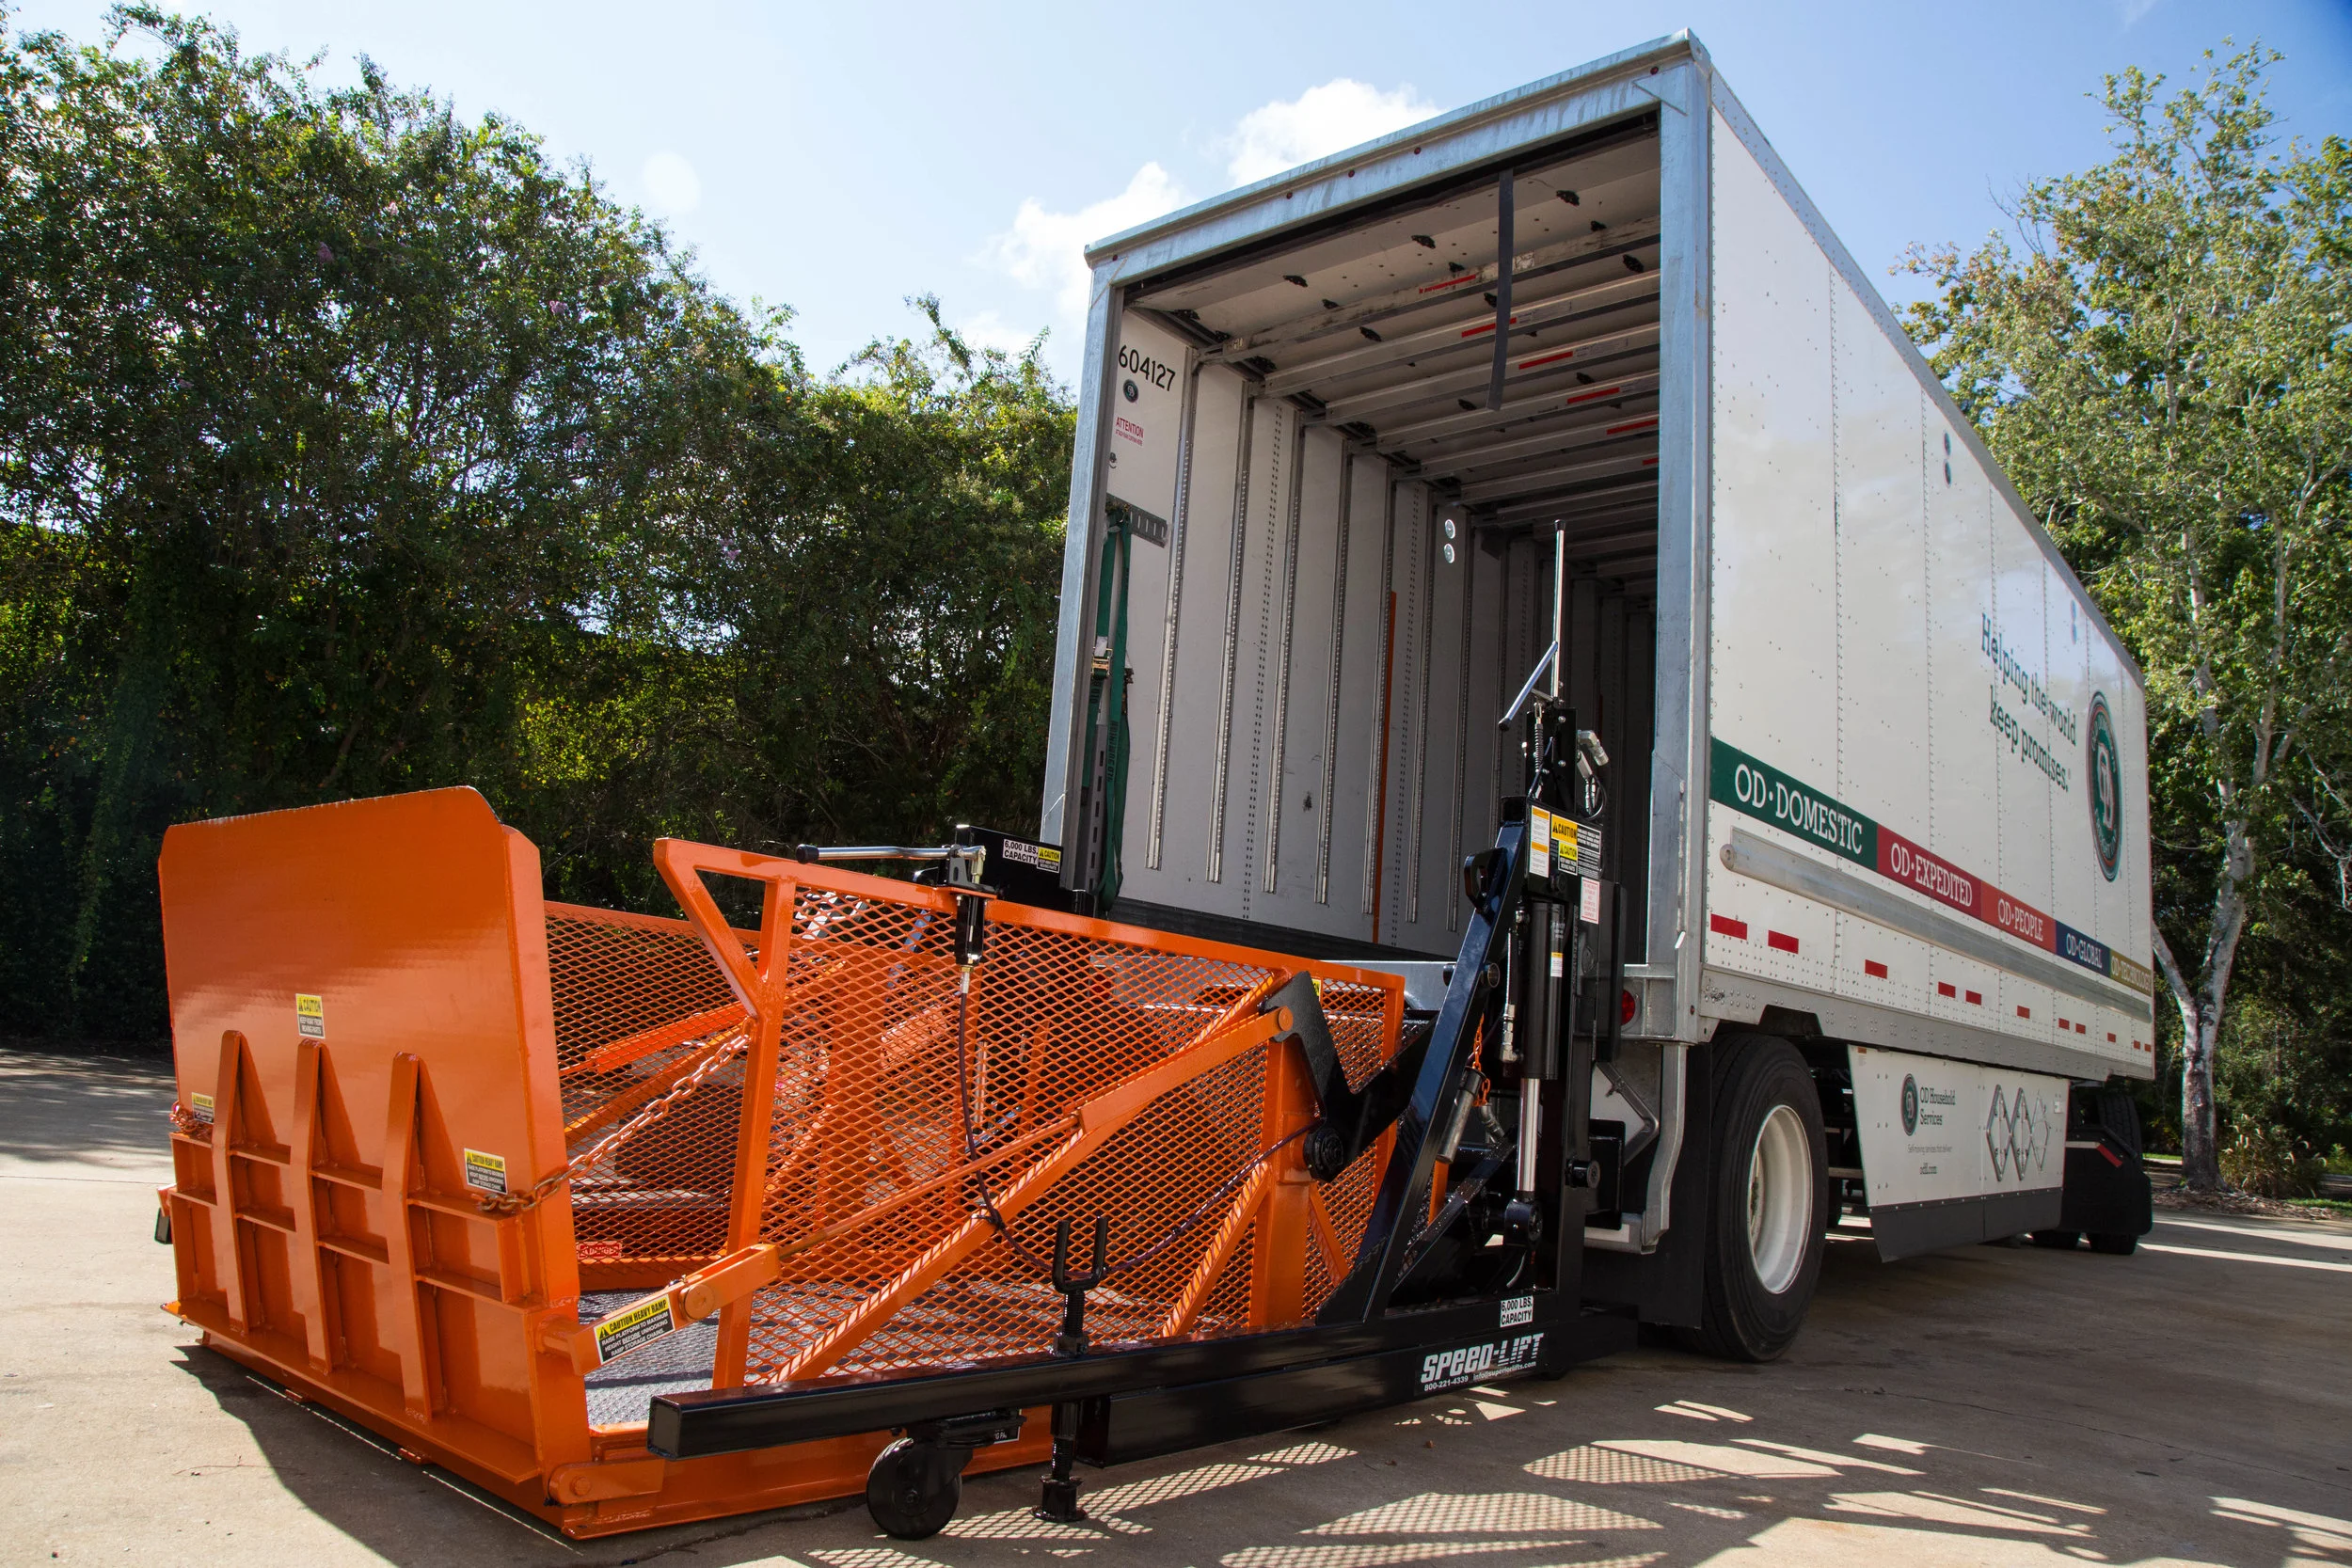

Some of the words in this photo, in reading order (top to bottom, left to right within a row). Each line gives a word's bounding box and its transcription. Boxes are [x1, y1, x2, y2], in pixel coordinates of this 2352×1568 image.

[1118, 344, 1176, 392] 604127
[1116, 417, 1144, 438] ATTENTION
[1981, 612, 2029, 705] Helping
[2030, 671, 2048, 716] the
[2049, 703, 2076, 747] world
[1989, 685, 2019, 753] keep
[1558, 823, 1577, 839] CAUTION
[1004, 850, 1037, 863] CAPACITY
[1005, 841, 1022, 850] 6,000
[1024, 845, 1039, 854] LBS.
[1044, 850, 1059, 860] CAUTION
[303, 999, 322, 1013] CAUTION
[1919, 1086, 1929, 1103] OD
[1930, 1087, 1955, 1106] Household
[1919, 1108, 1943, 1125] Services
[1502, 1300, 1518, 1313] 6,000
[1519, 1297, 1532, 1308] LBS.
[609, 1315, 633, 1333] CAUTION
[633, 1307, 651, 1322] HEAVY
[651, 1300, 667, 1313] RAMP
[1502, 1309, 1532, 1324] CAPACITY
[601, 1335, 615, 1346] RAISE
[615, 1324, 641, 1339] PLATFORM
[647, 1311, 668, 1324] MAXIMUM
[604, 1340, 622, 1353] HEIGHT
[622, 1332, 641, 1345] BEFORE
[641, 1319, 668, 1336] UNHOOKING
[611, 1346, 625, 1356] RAMP
[625, 1336, 646, 1351] STORAGE
[1424, 1375, 1469, 1392] 800-221-4339
[1473, 1362, 1536, 1381] info@superiorlifts.com
